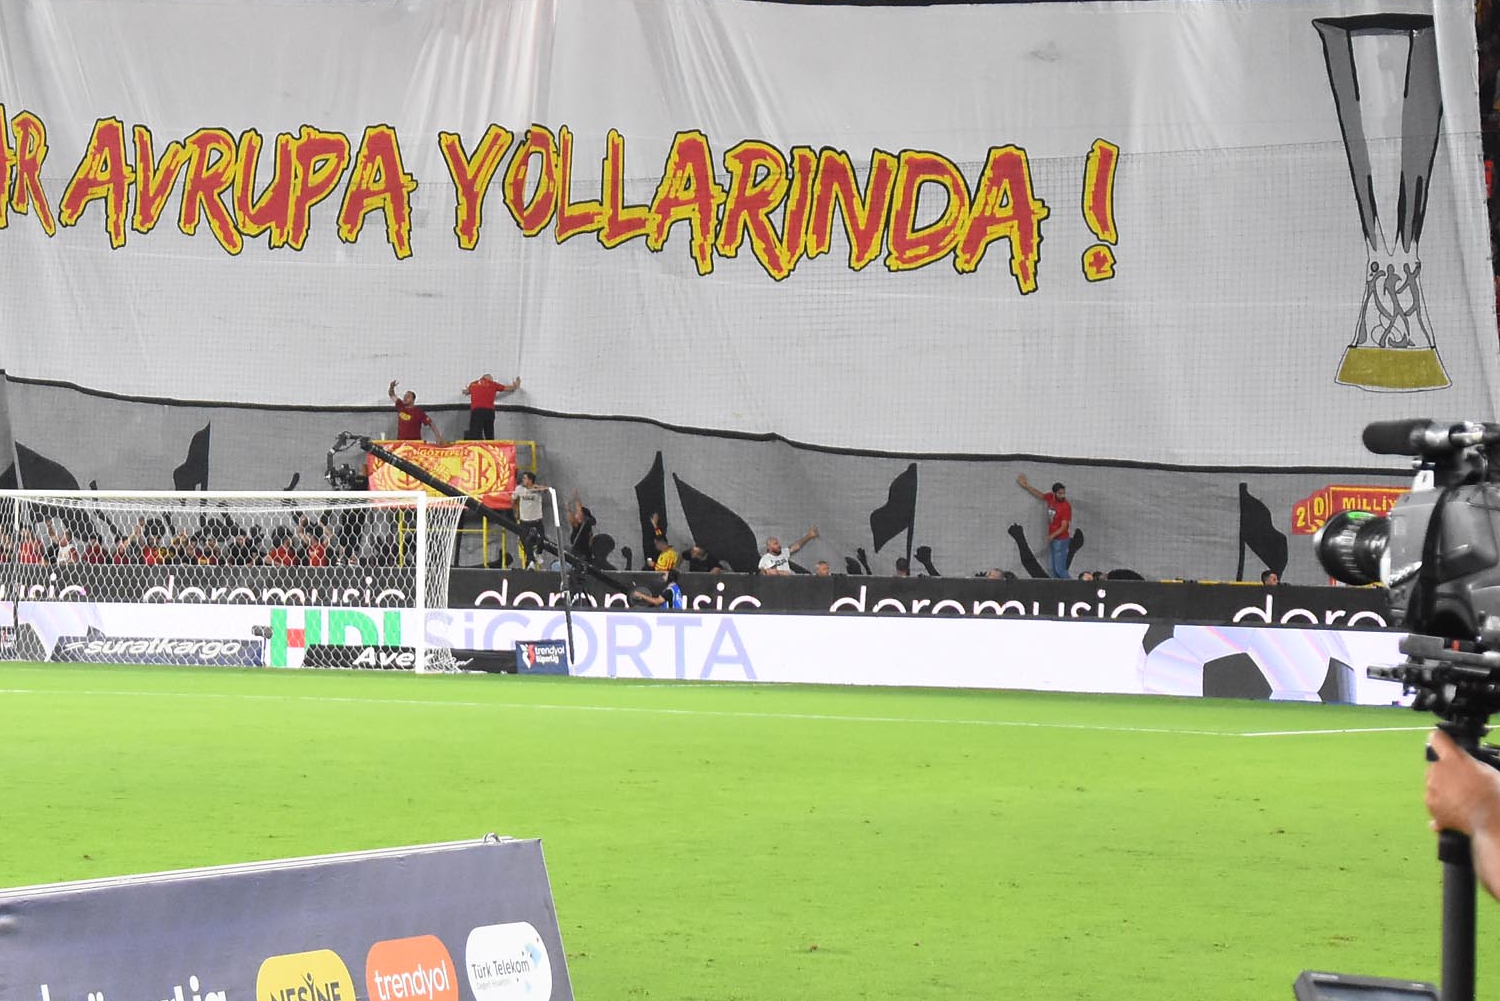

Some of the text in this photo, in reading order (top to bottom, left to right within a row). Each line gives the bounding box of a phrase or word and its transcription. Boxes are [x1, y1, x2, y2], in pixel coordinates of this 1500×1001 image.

[60, 117, 418, 260] AVRUPA
[437, 124, 1049, 295] YOLLARINDA
[374, 960, 450, 1001] trendyol
[472, 959, 530, 979] Türk Telekom
